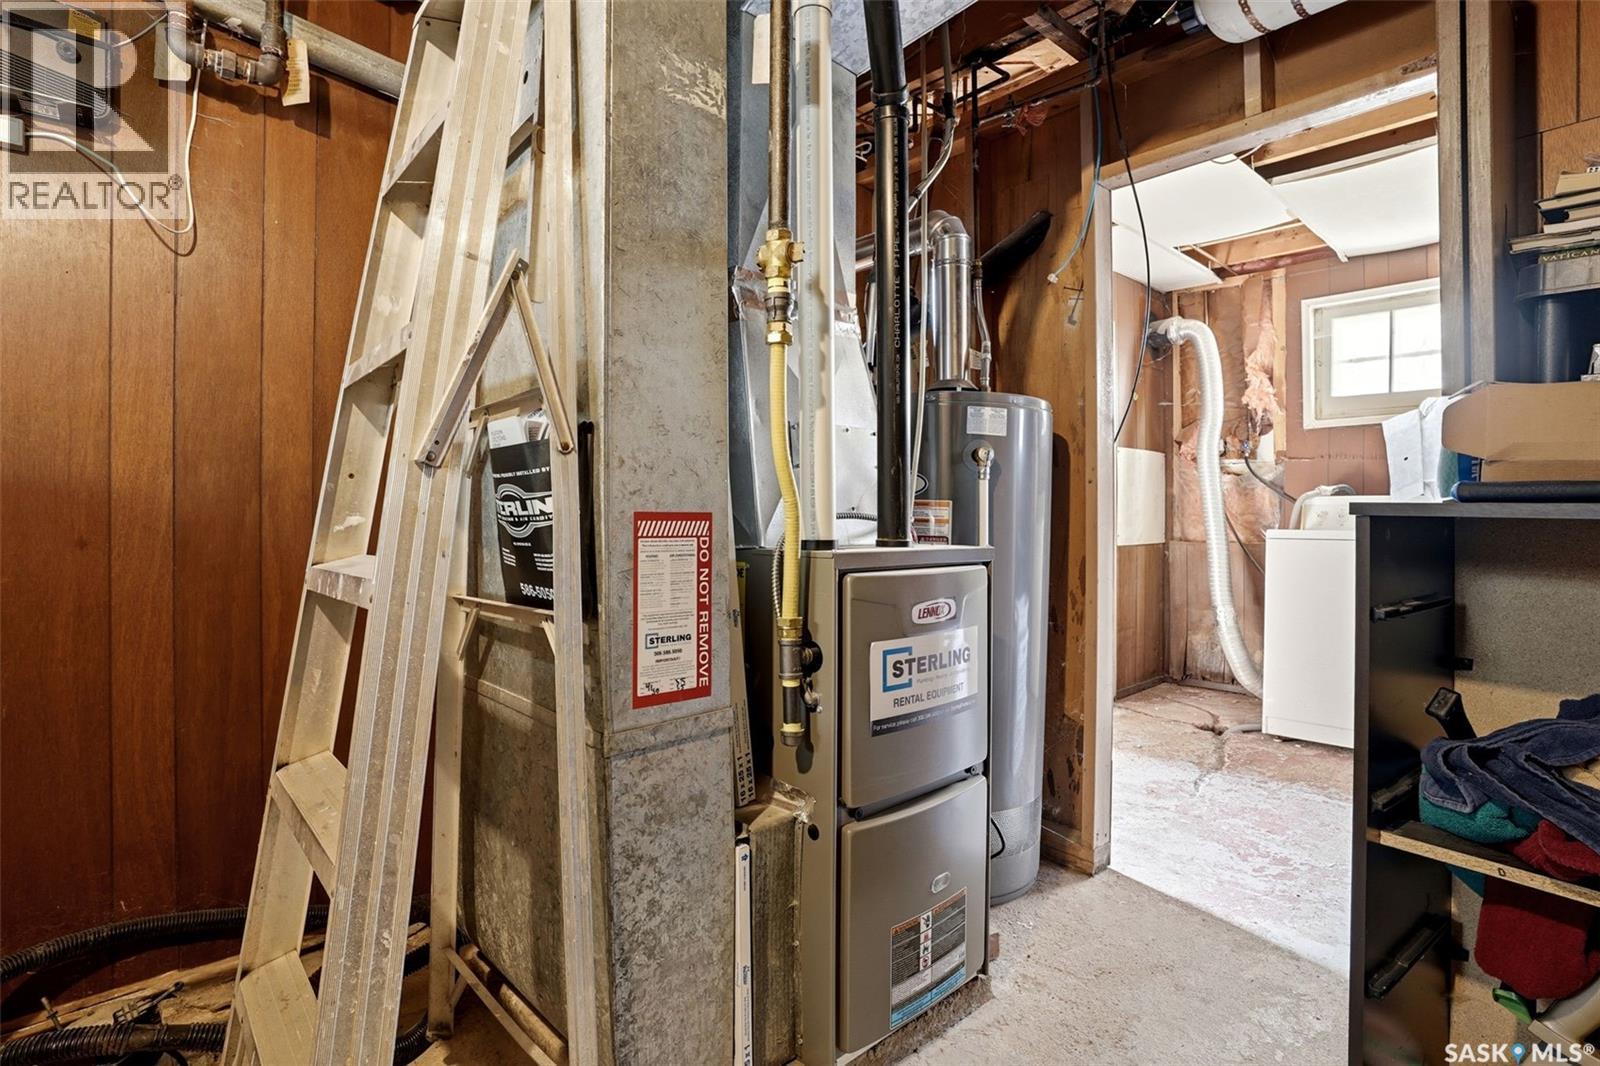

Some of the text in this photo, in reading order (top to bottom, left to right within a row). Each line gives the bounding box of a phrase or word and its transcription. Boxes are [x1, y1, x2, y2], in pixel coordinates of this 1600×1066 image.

[893, 236, 901, 268] PIPE
[1542, 249, 1600, 262] VATICAN
[893, 274, 901, 348] CHARLOTTE
[698, 537, 710, 688] DO NOT REMOVE
[918, 602, 946, 620] LENNOX
[649, 633, 692, 646] STERLING
[892, 647, 971, 679] STERLING
[893, 682, 964, 709] RENTAL EQUIPMENT
[738, 770, 745, 783] 25
